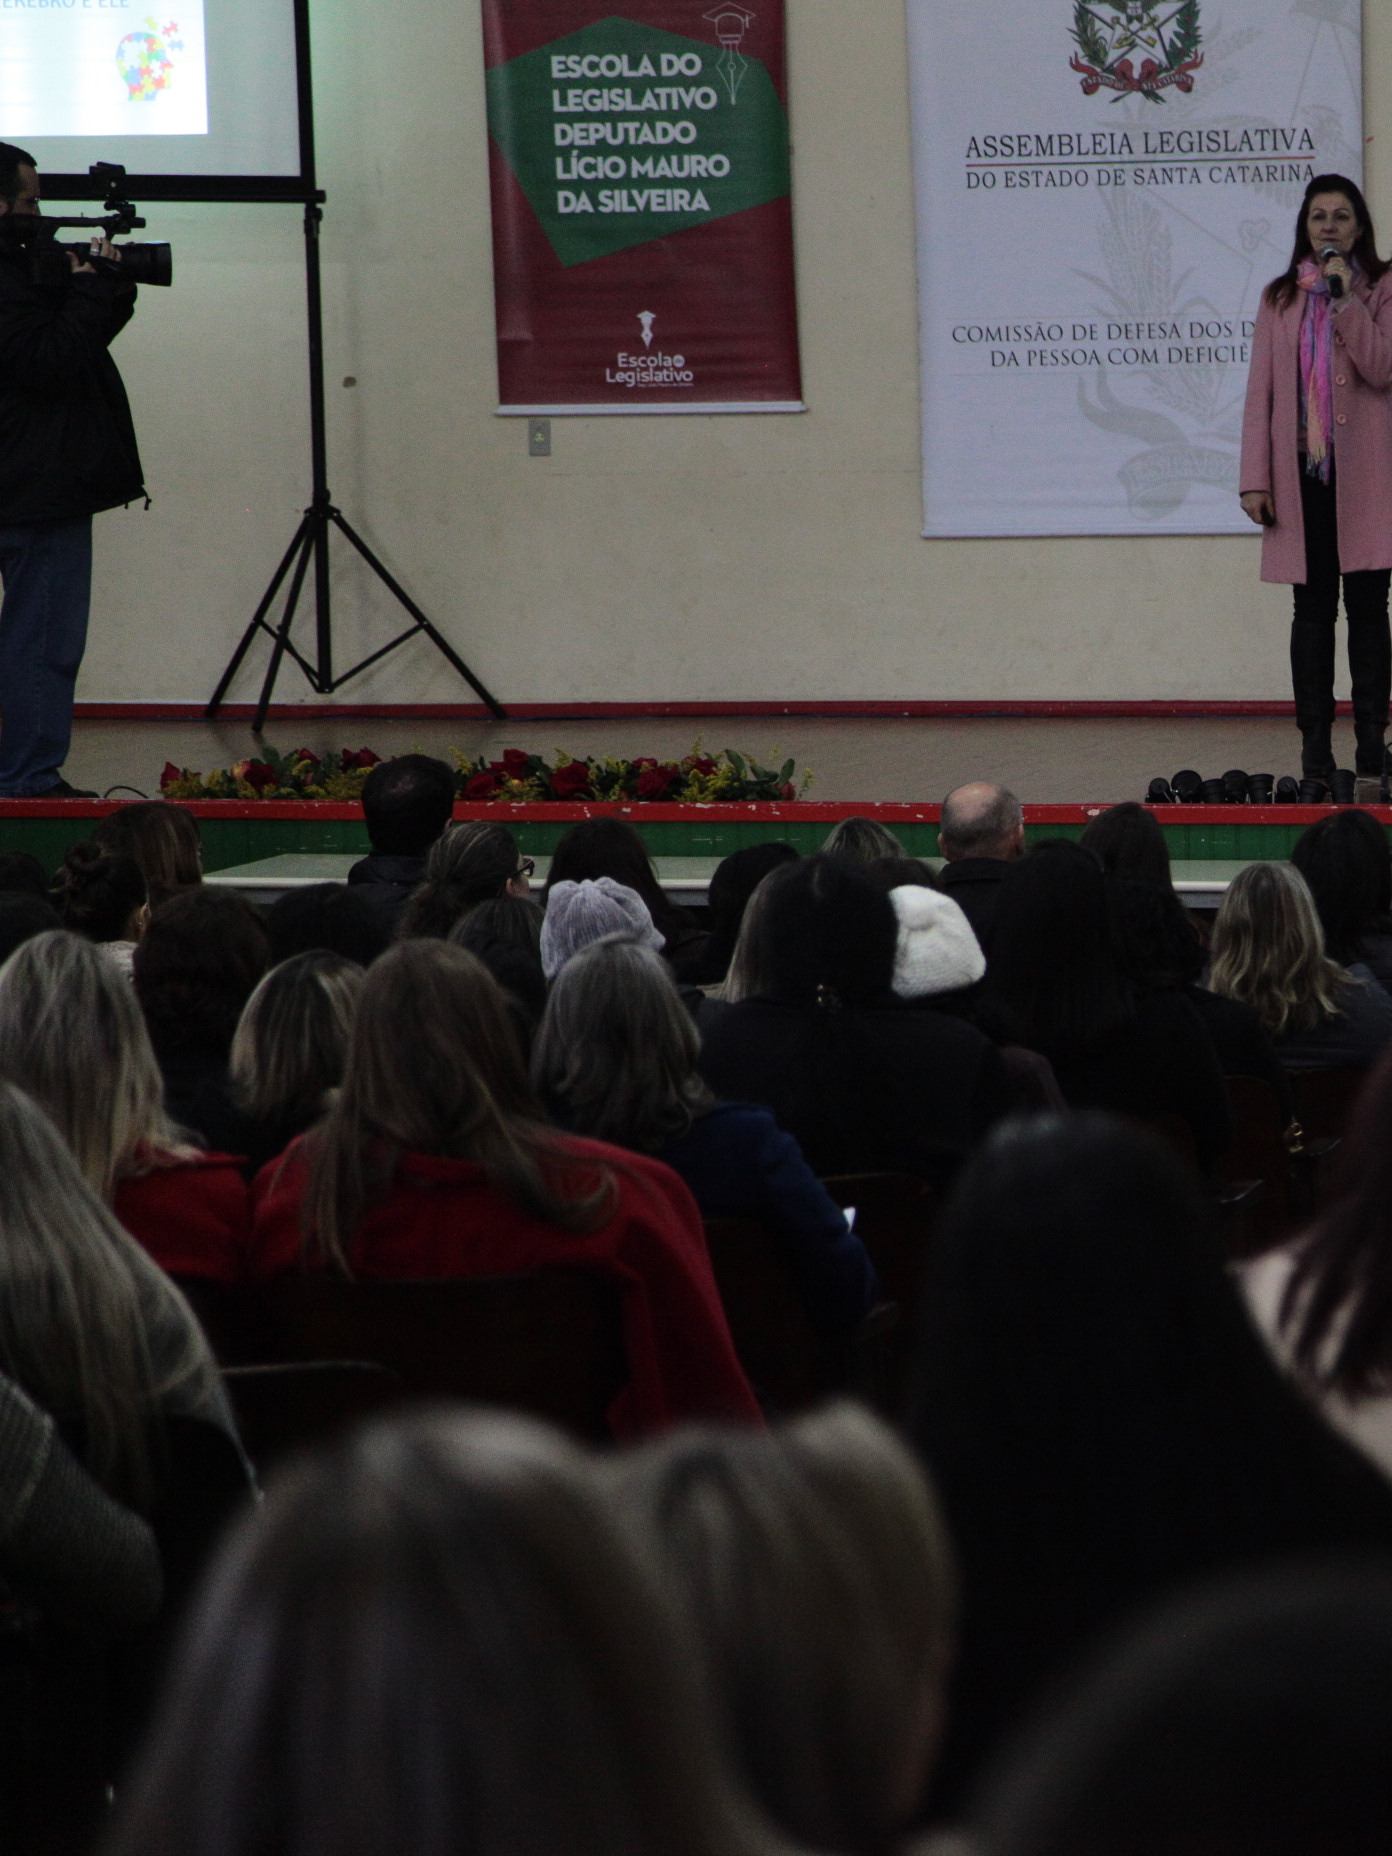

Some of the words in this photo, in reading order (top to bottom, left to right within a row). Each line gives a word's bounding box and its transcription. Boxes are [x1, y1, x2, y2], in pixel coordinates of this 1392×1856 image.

[551, 53, 657, 79] ESCOLA
[660, 52, 702, 77] DO
[552, 86, 718, 112] LEGISLATIVO
[554, 121, 697, 146] DEPUTADO
[965, 132, 1134, 158] ASSEMBLEIA
[1143, 128, 1315, 154] LEGISLATIVA
[556, 150, 627, 180] LÍCIO
[631, 154, 731, 179] MAURO
[966, 171, 997, 189] DO
[1004, 169, 1089, 188] ESTADO
[1097, 168, 1126, 186] DE
[1133, 166, 1202, 185] SANTA
[1209, 164, 1315, 184] CATARINA
[557, 190, 595, 213] DA
[598, 187, 711, 213] SILVEIRA
[952, 321, 1063, 343] COMISSÃO
[1072, 323, 1099, 341] DE
[1107, 322, 1182, 341] DEFESA
[1189, 321, 1233, 339] DOS
[617, 351, 672, 368] Escola
[991, 350, 1019, 368] DA
[1027, 349, 1101, 367] PESSOA
[1108, 347, 1160, 365] COM
[1167, 342, 1249, 364] DEFICIÊ
[605, 367, 693, 388] Legislativo
